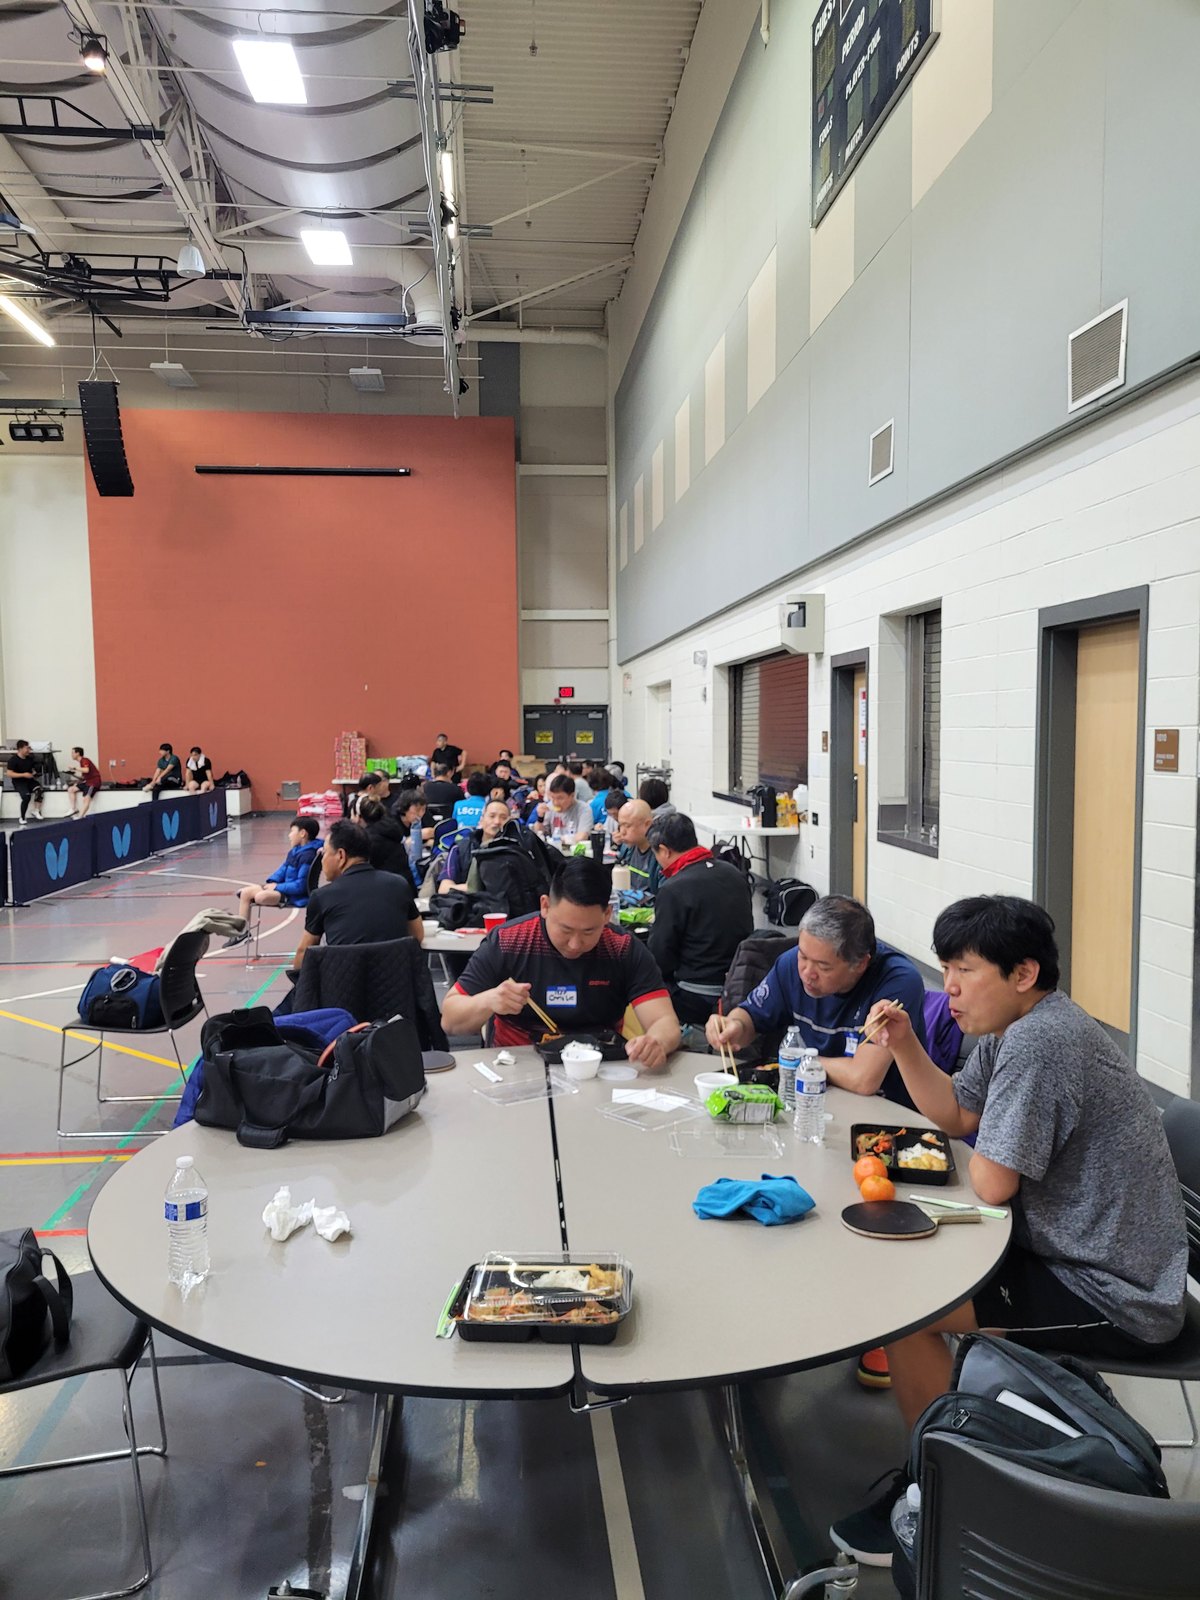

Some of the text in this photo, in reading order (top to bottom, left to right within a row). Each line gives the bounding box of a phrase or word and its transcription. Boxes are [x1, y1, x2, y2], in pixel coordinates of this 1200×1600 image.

[841, 6, 866, 64] PERIOD
[895, 30, 919, 80] POINTS
[818, 115, 833, 148] FOULS
